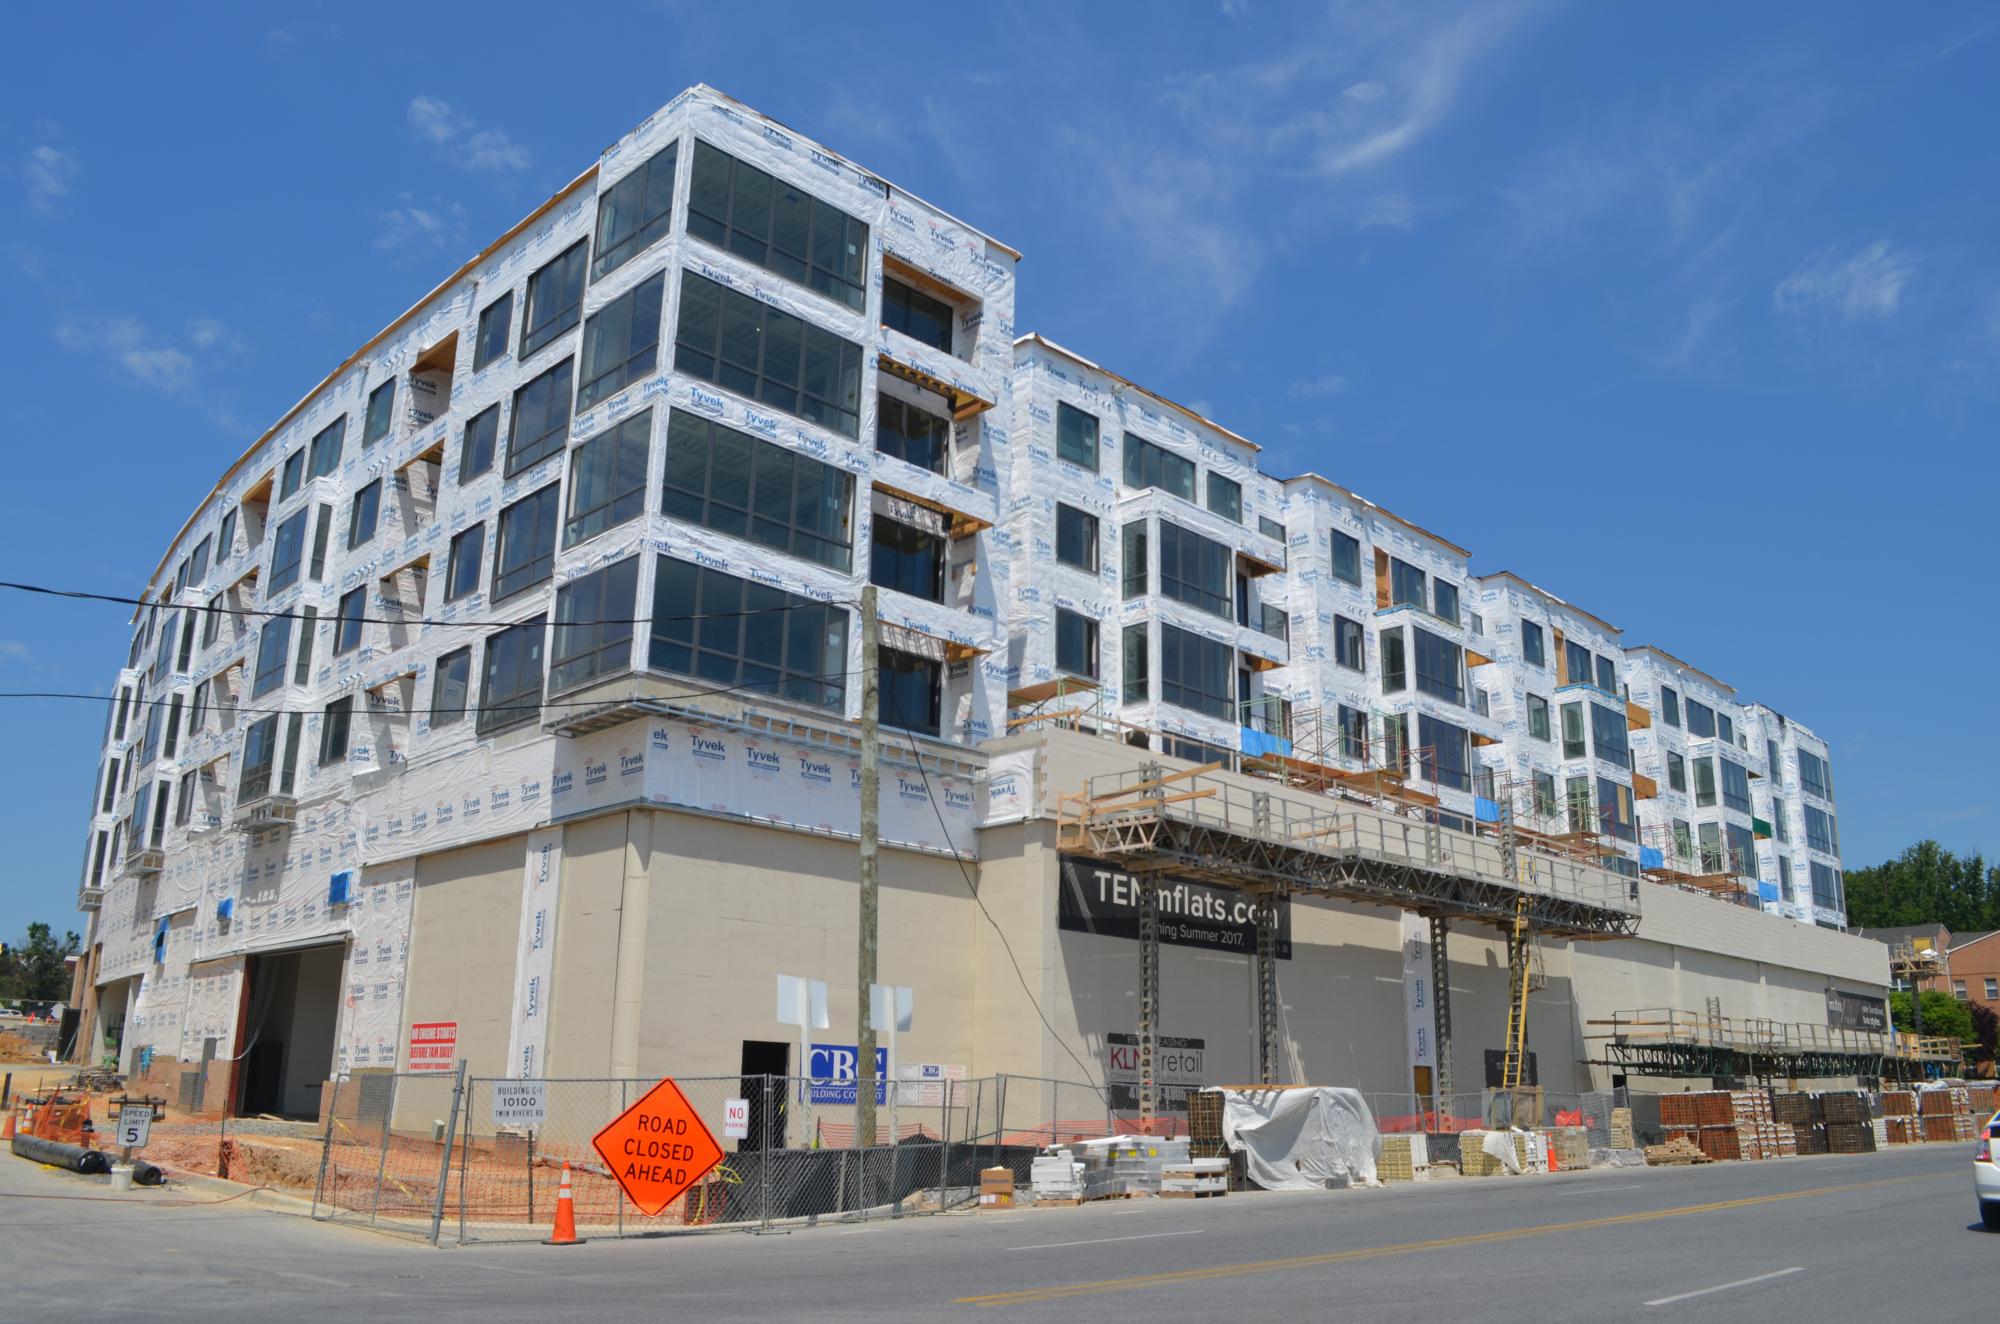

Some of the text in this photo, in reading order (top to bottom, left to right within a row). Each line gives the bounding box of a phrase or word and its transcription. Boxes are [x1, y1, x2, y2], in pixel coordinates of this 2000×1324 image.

[890, 207, 915, 226] Tyvek
[930, 228, 955, 245] Tyvek
[910, 359, 936, 376] Tyvek
[409, 374, 437, 390] Tyvek
[643, 376, 669, 392] Tyvek
[952, 378, 978, 394] Tyvek
[690, 387, 724, 408] Tyvek
[745, 408, 776, 430] Tyvek
[983, 421, 1007, 438] Tyvek
[796, 430, 827, 451] Tyvek
[972, 466, 997, 480] Tyvek
[694, 550, 729, 570] Tyvek
[750, 568, 782, 587] Tyvek
[802, 583, 833, 601] Tyvek
[968, 604, 993, 617] Tyvek
[903, 617, 931, 634] Tyvek
[947, 630, 975, 646] Tyvek
[371, 694, 399, 706] Tyvek
[963, 719, 988, 731] Tyvek
[690, 734, 725, 752] Tyvek
[621, 752, 643, 768] Tyvek
[746, 747, 780, 764] Tyvek
[585, 762, 607, 778] Tyvek
[800, 758, 831, 775] Tyvek
[552, 771, 573, 787] Tyvek
[898, 778, 927, 794] Tyvek
[491, 789, 510, 804] Tyvek
[521, 781, 541, 796] Tyvek
[944, 788, 970, 802] Tyvek
[437, 805, 453, 818] Tyvek
[463, 797, 481, 810] Tyvek
[412, 812, 427, 825] Tyvek
[538, 844, 548, 885] Tyvek
[532, 910, 543, 952] Tyvek
[1180, 924, 1219, 942] Summer
[527, 977, 537, 1019] Tyvek
[1161, 1051, 1203, 1072] retail
[497, 1086, 530, 1095] BUILDING
[503, 1097, 537, 1107] 10100
[124, 1109, 149, 1118] SPEED
[495, 1110, 510, 1118] TWIN
[512, 1109, 533, 1118] RIVERS
[729, 1107, 744, 1120] NO
[638, 1114, 687, 1136] ROAD
[126, 1128, 139, 1143] 5
[624, 1138, 694, 1162] CLOSED
[624, 1163, 687, 1185] AHEAD
